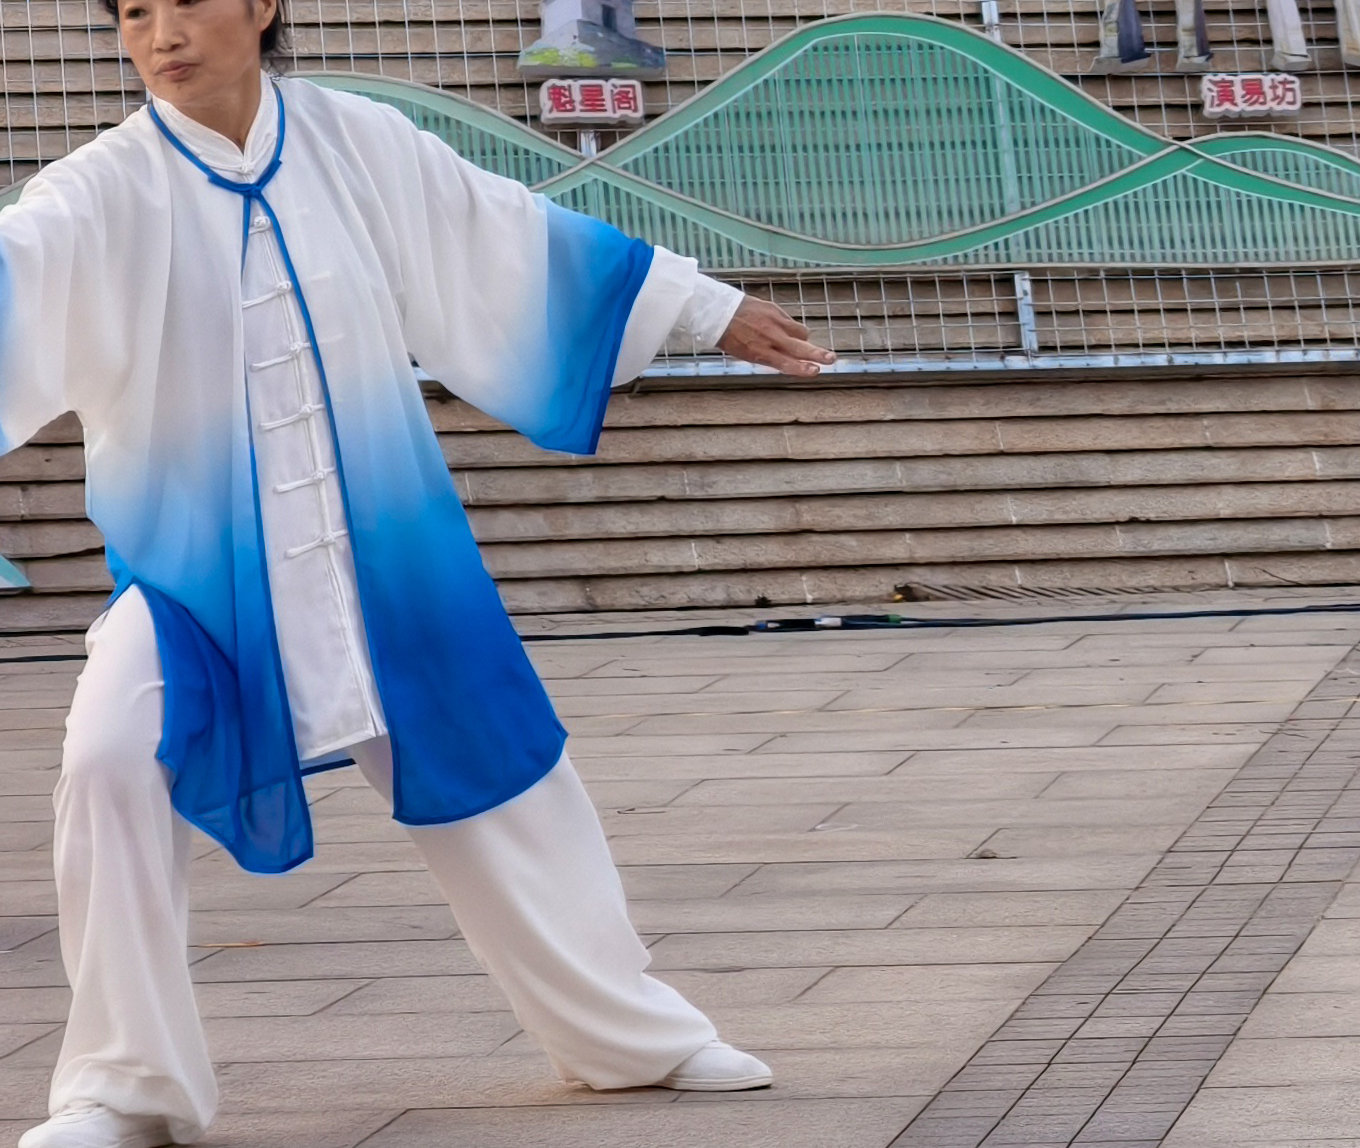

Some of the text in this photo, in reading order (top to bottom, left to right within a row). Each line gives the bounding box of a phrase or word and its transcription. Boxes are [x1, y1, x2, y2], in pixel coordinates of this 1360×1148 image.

[547, 83, 638, 114] 魁星阁
[1206, 77, 1298, 109] 演易坊
